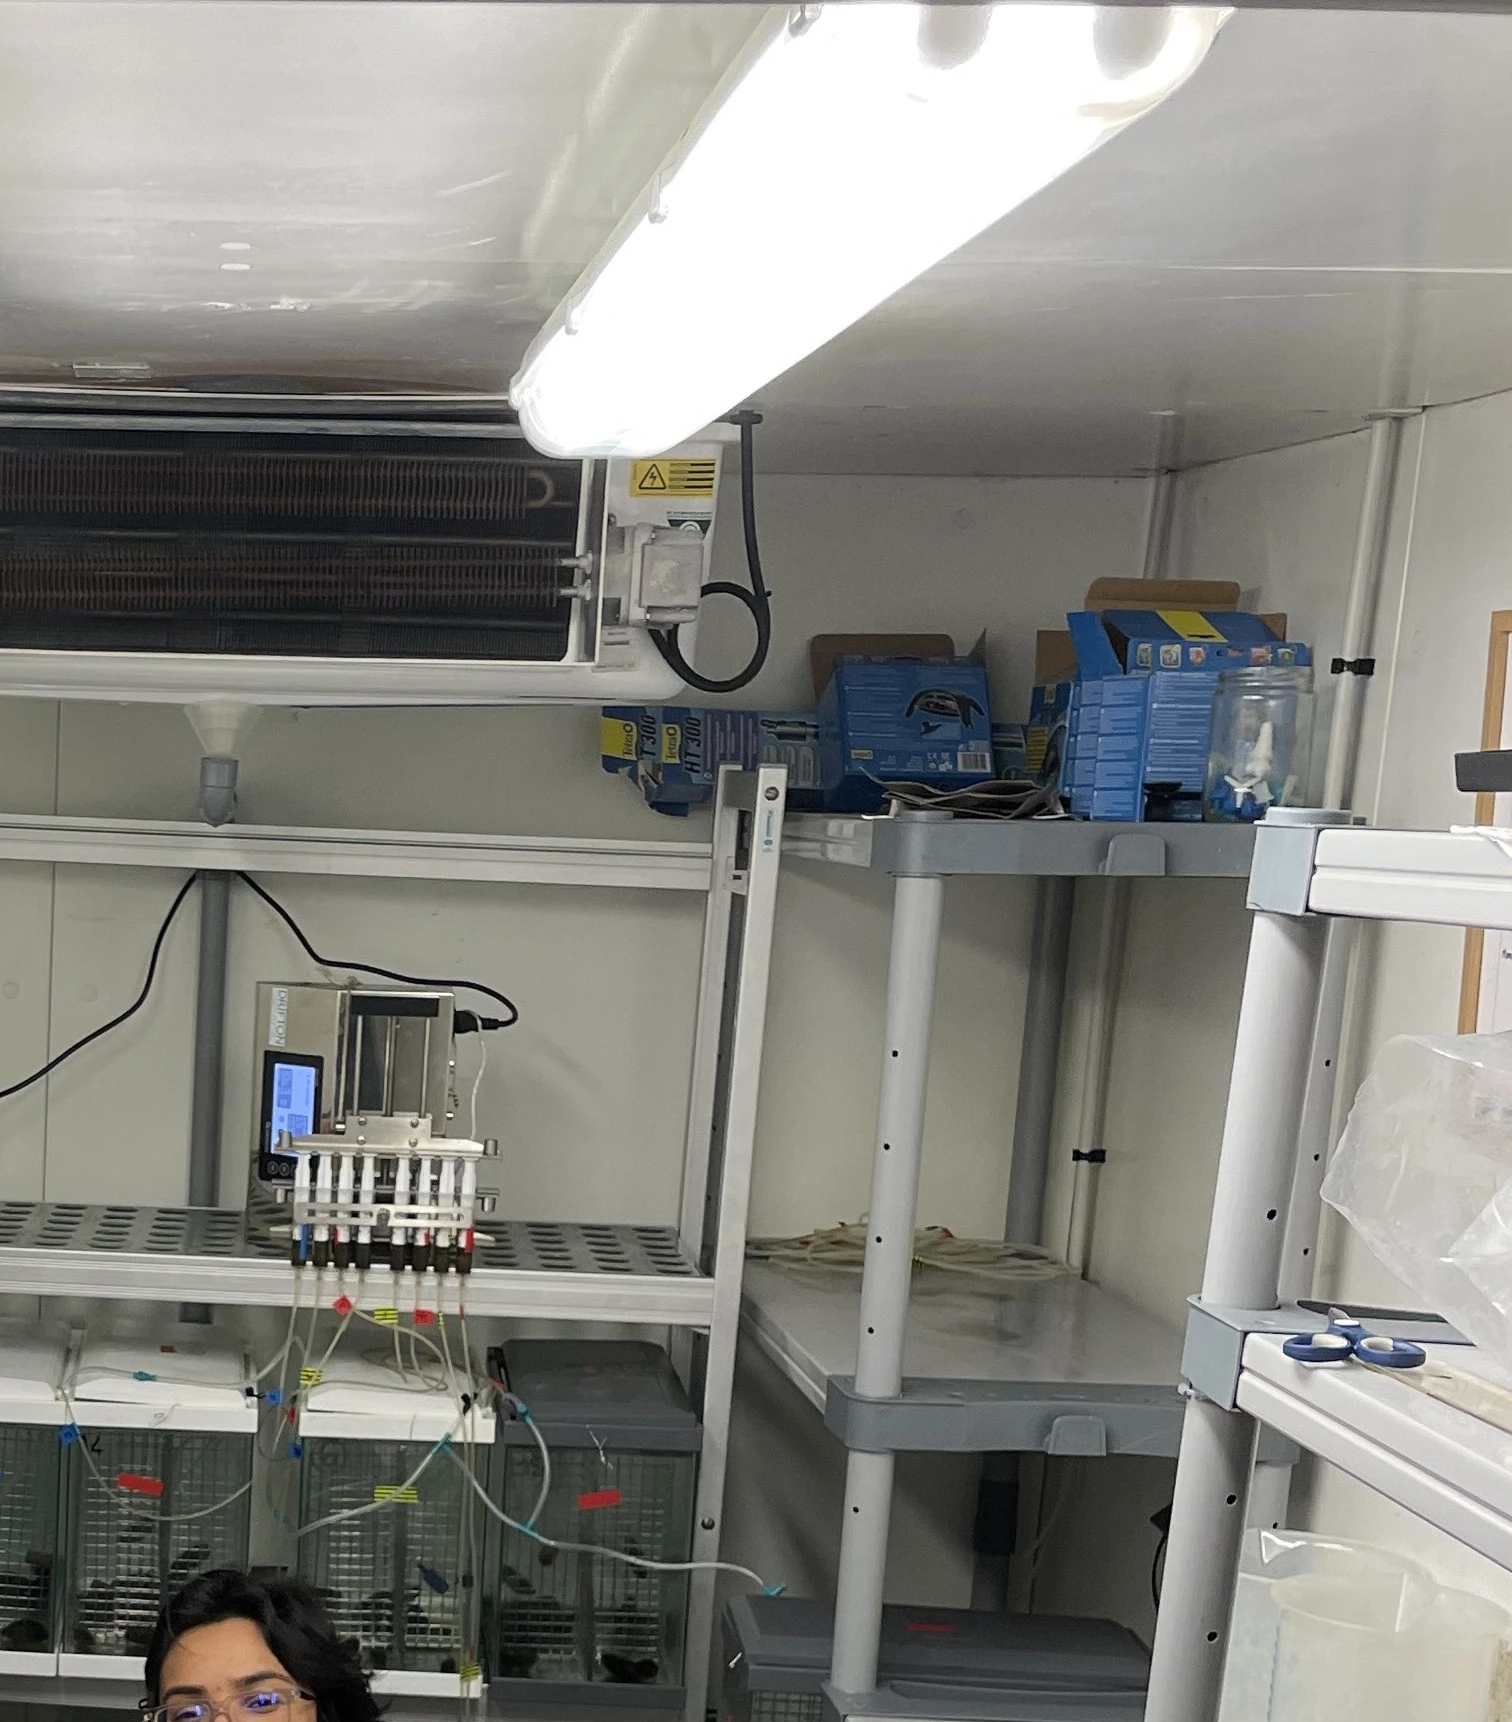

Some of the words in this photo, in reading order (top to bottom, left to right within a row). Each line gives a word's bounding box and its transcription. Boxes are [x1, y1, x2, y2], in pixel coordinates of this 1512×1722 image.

[665, 727, 679, 761] Tetra
[685, 716, 702, 746] 300
[685, 746, 701, 774] HT
[276, 989, 288, 1045] DRIFTON
